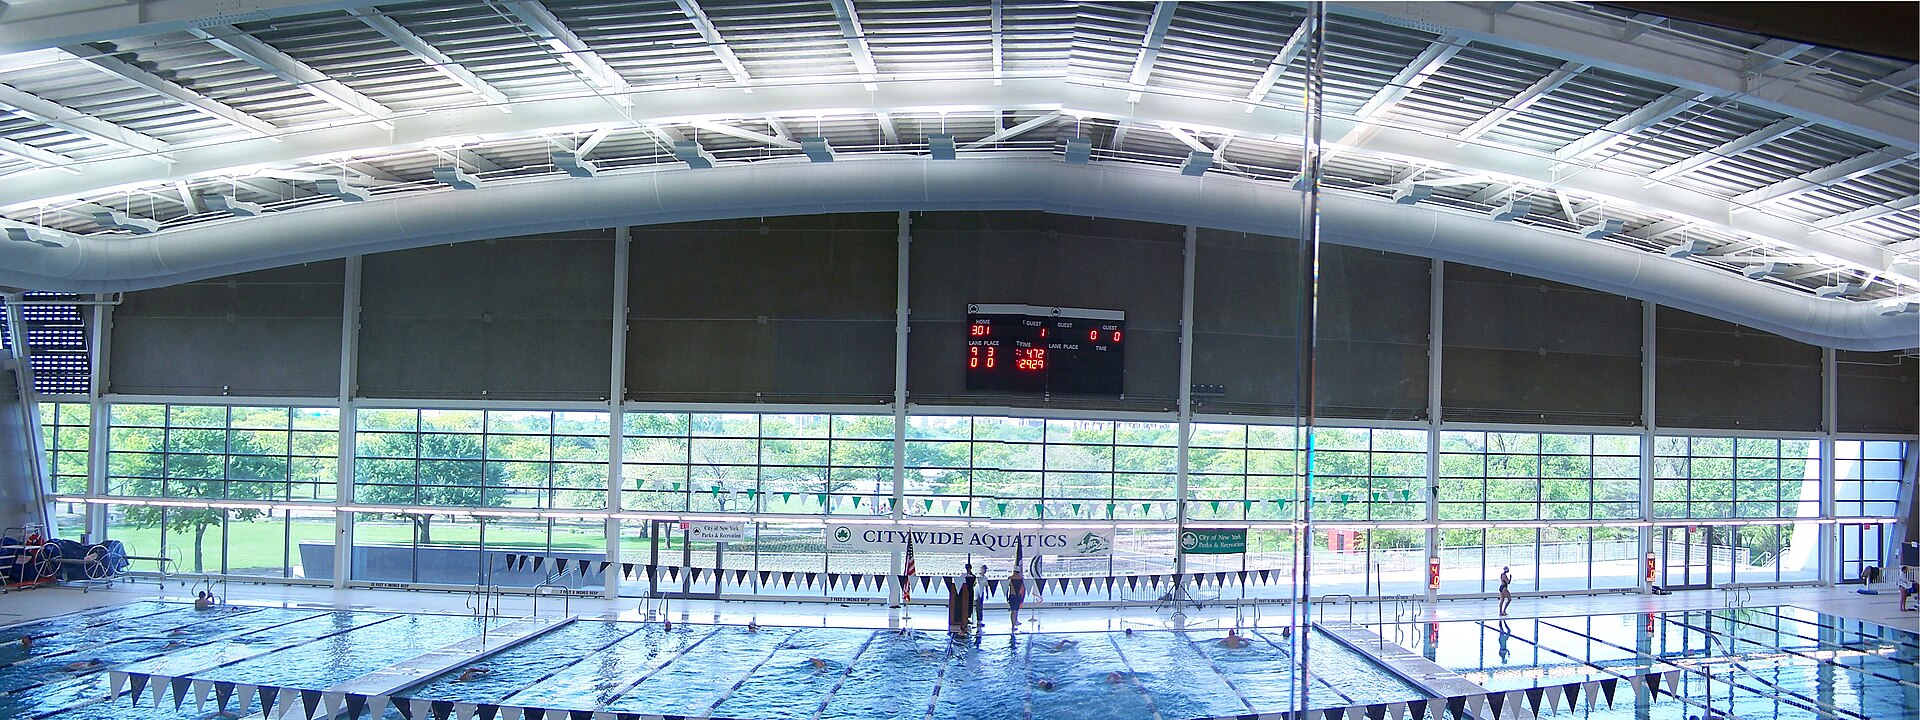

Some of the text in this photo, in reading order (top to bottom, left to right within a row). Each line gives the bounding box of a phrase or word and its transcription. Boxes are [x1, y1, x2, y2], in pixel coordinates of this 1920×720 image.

[971, 325, 990, 335] 301
[1090, 330, 1097, 340] 0
[1113, 331, 1121, 342] 0
[971, 346, 978, 356] 9
[987, 346, 994, 357] 3
[970, 357, 978, 368] 0
[986, 357, 994, 368] 0
[863, 529, 1067, 552] CITYWIDE AQUATICS
[1198, 534, 1210, 542] City
[1431, 565, 1438, 574] 4
[1433, 575, 1440, 585] 0
